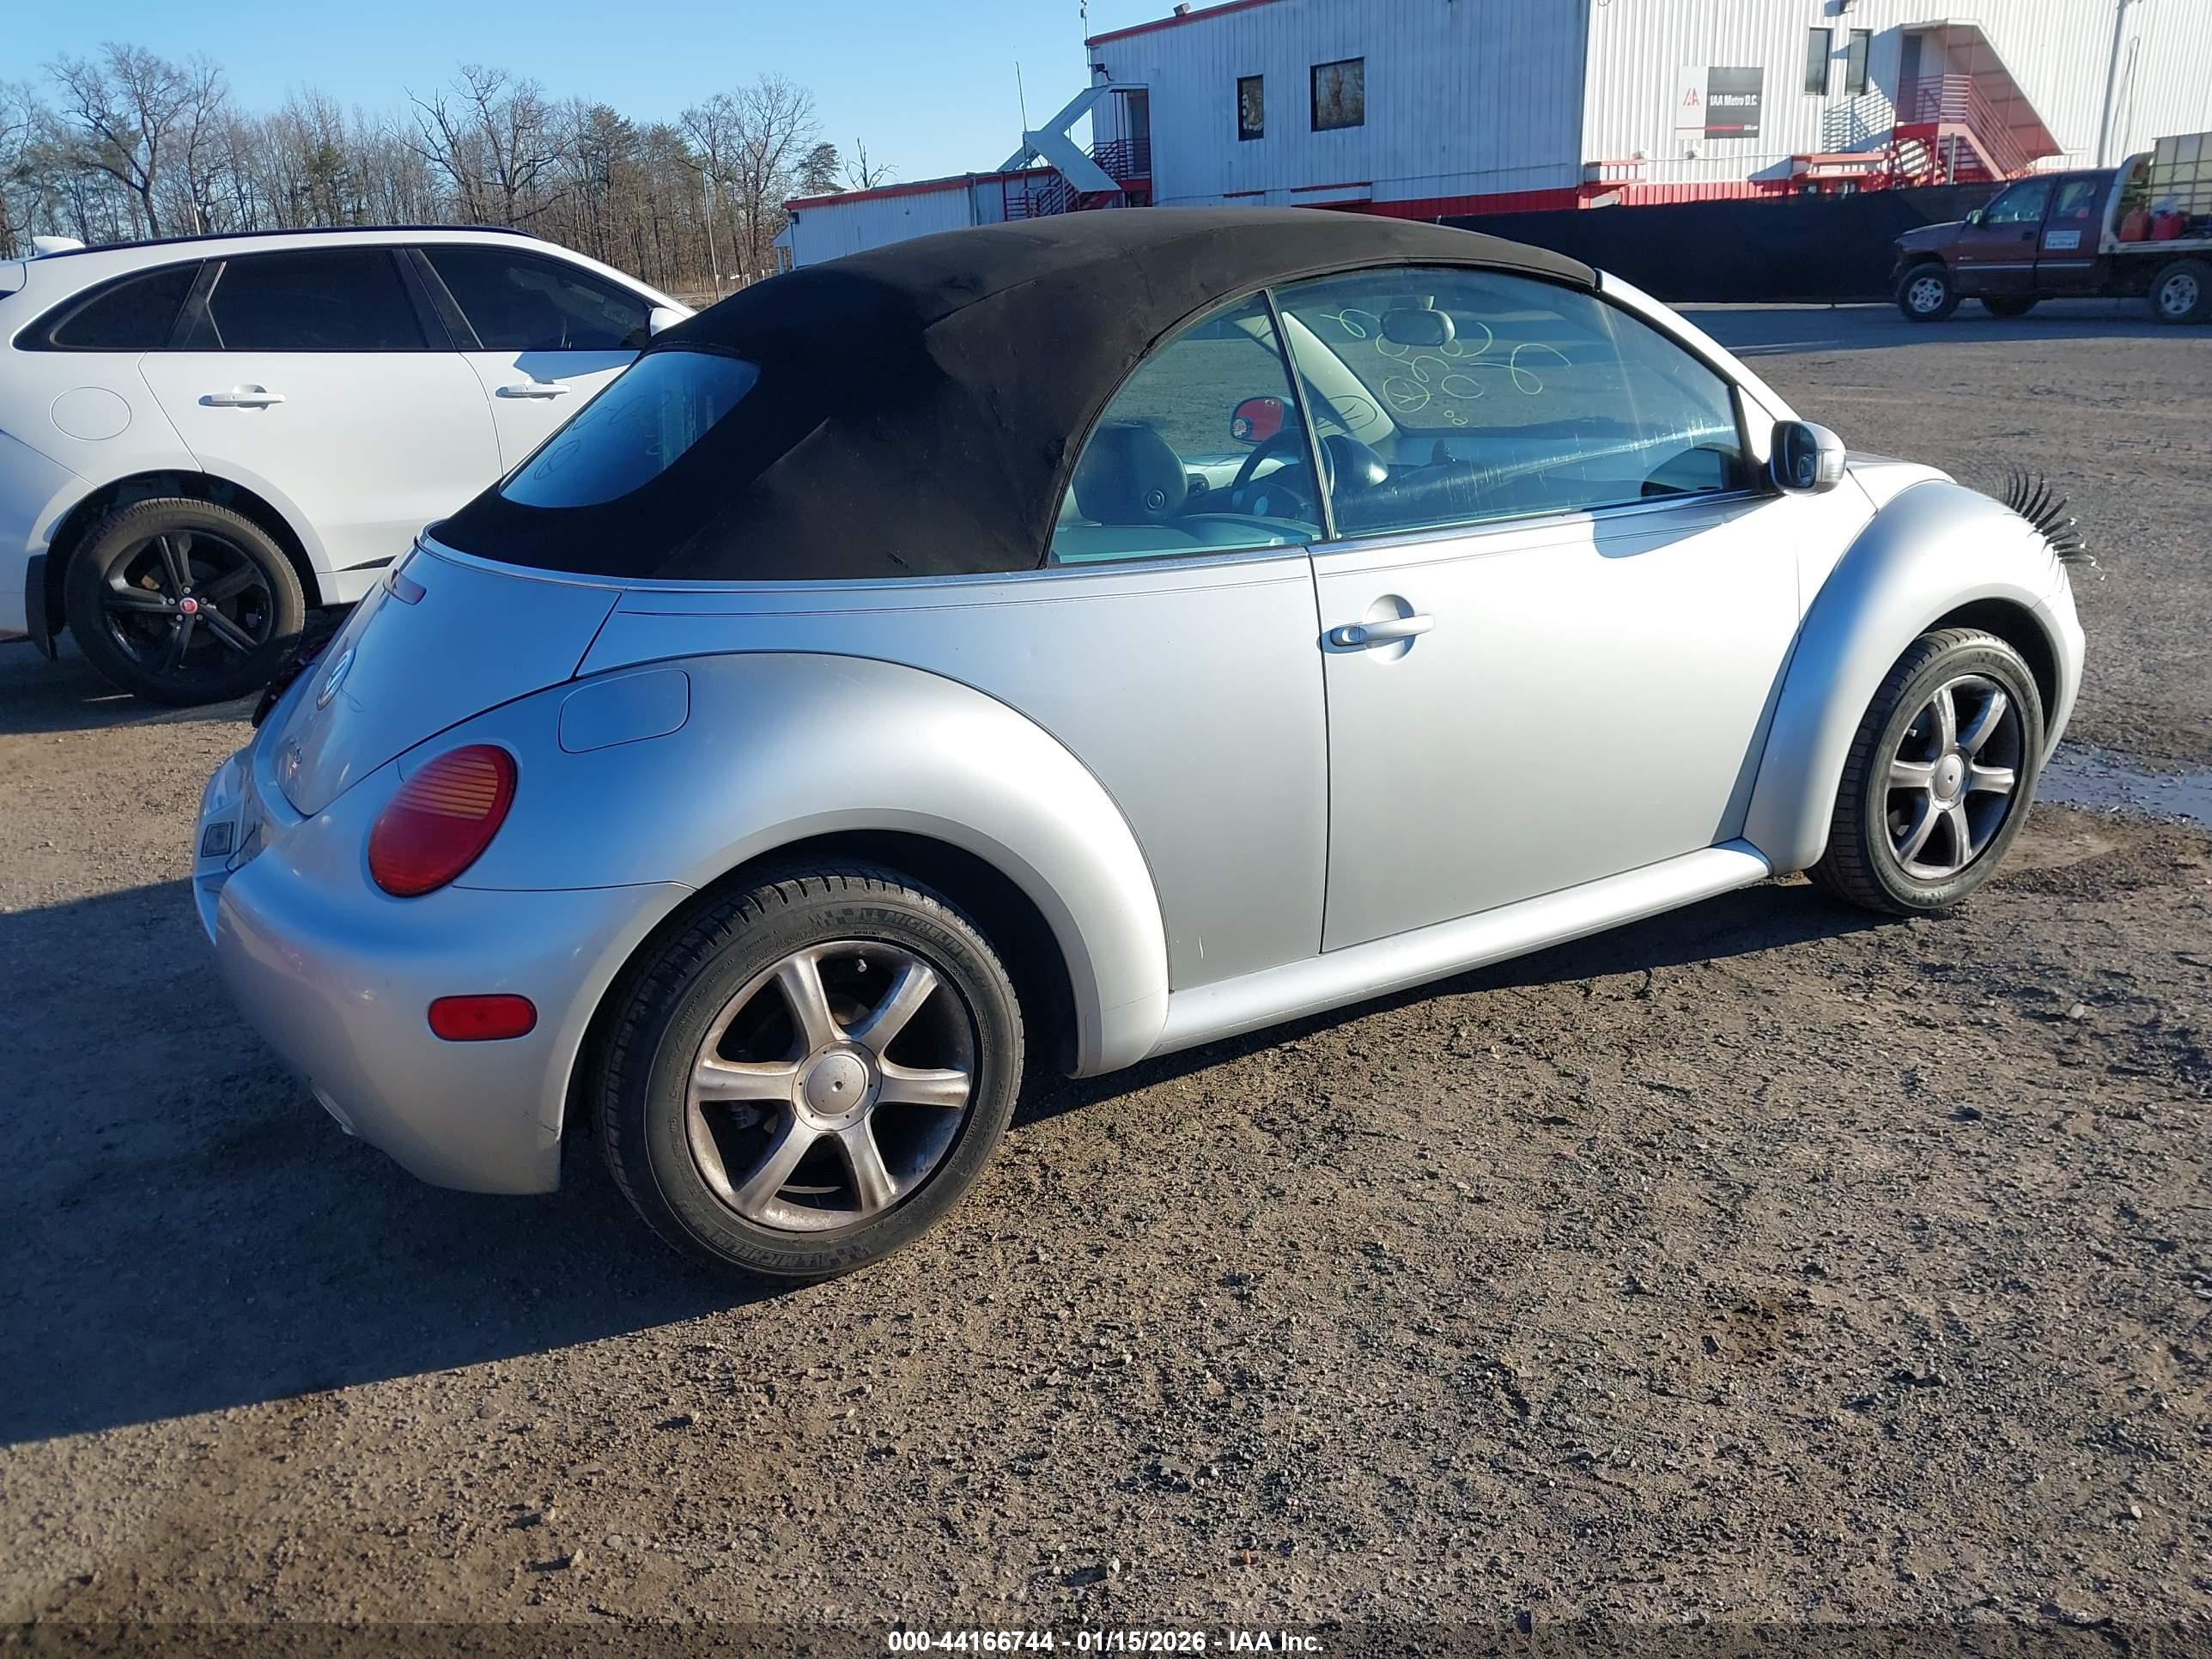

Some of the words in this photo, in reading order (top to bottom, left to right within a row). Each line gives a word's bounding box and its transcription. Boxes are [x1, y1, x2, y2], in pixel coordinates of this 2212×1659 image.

[1710, 94, 1723, 106] IAA
[1723, 94, 1744, 106] Metro
[1745, 94, 1758, 106] D.C.
[884, 908, 965, 957] MICHELIN
